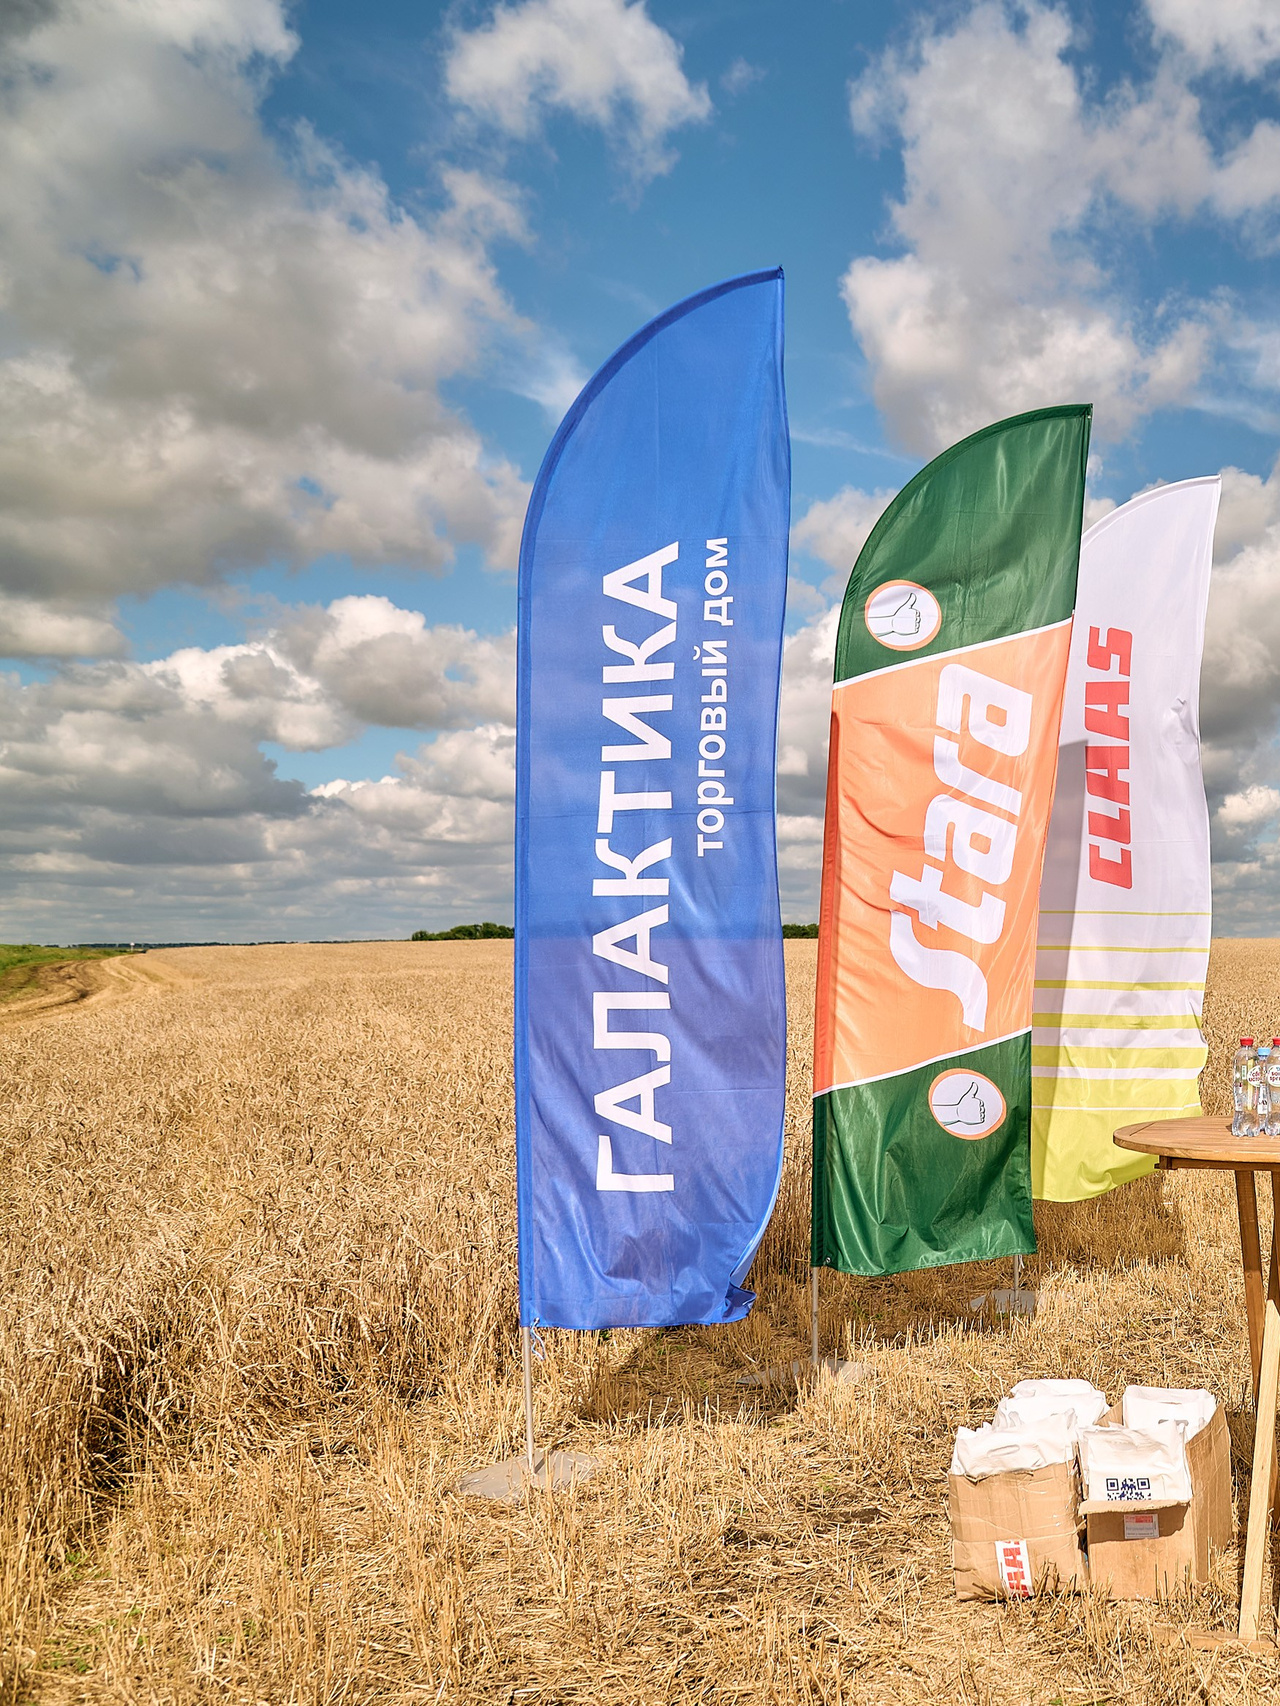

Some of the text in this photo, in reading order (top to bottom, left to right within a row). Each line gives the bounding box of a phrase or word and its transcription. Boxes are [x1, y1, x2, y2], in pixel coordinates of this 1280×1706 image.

[692, 537, 735, 858] торговый дом
[1085, 625, 1133, 890] CLAAS
[591, 540, 680, 1194] ГАЛАКТИКА
